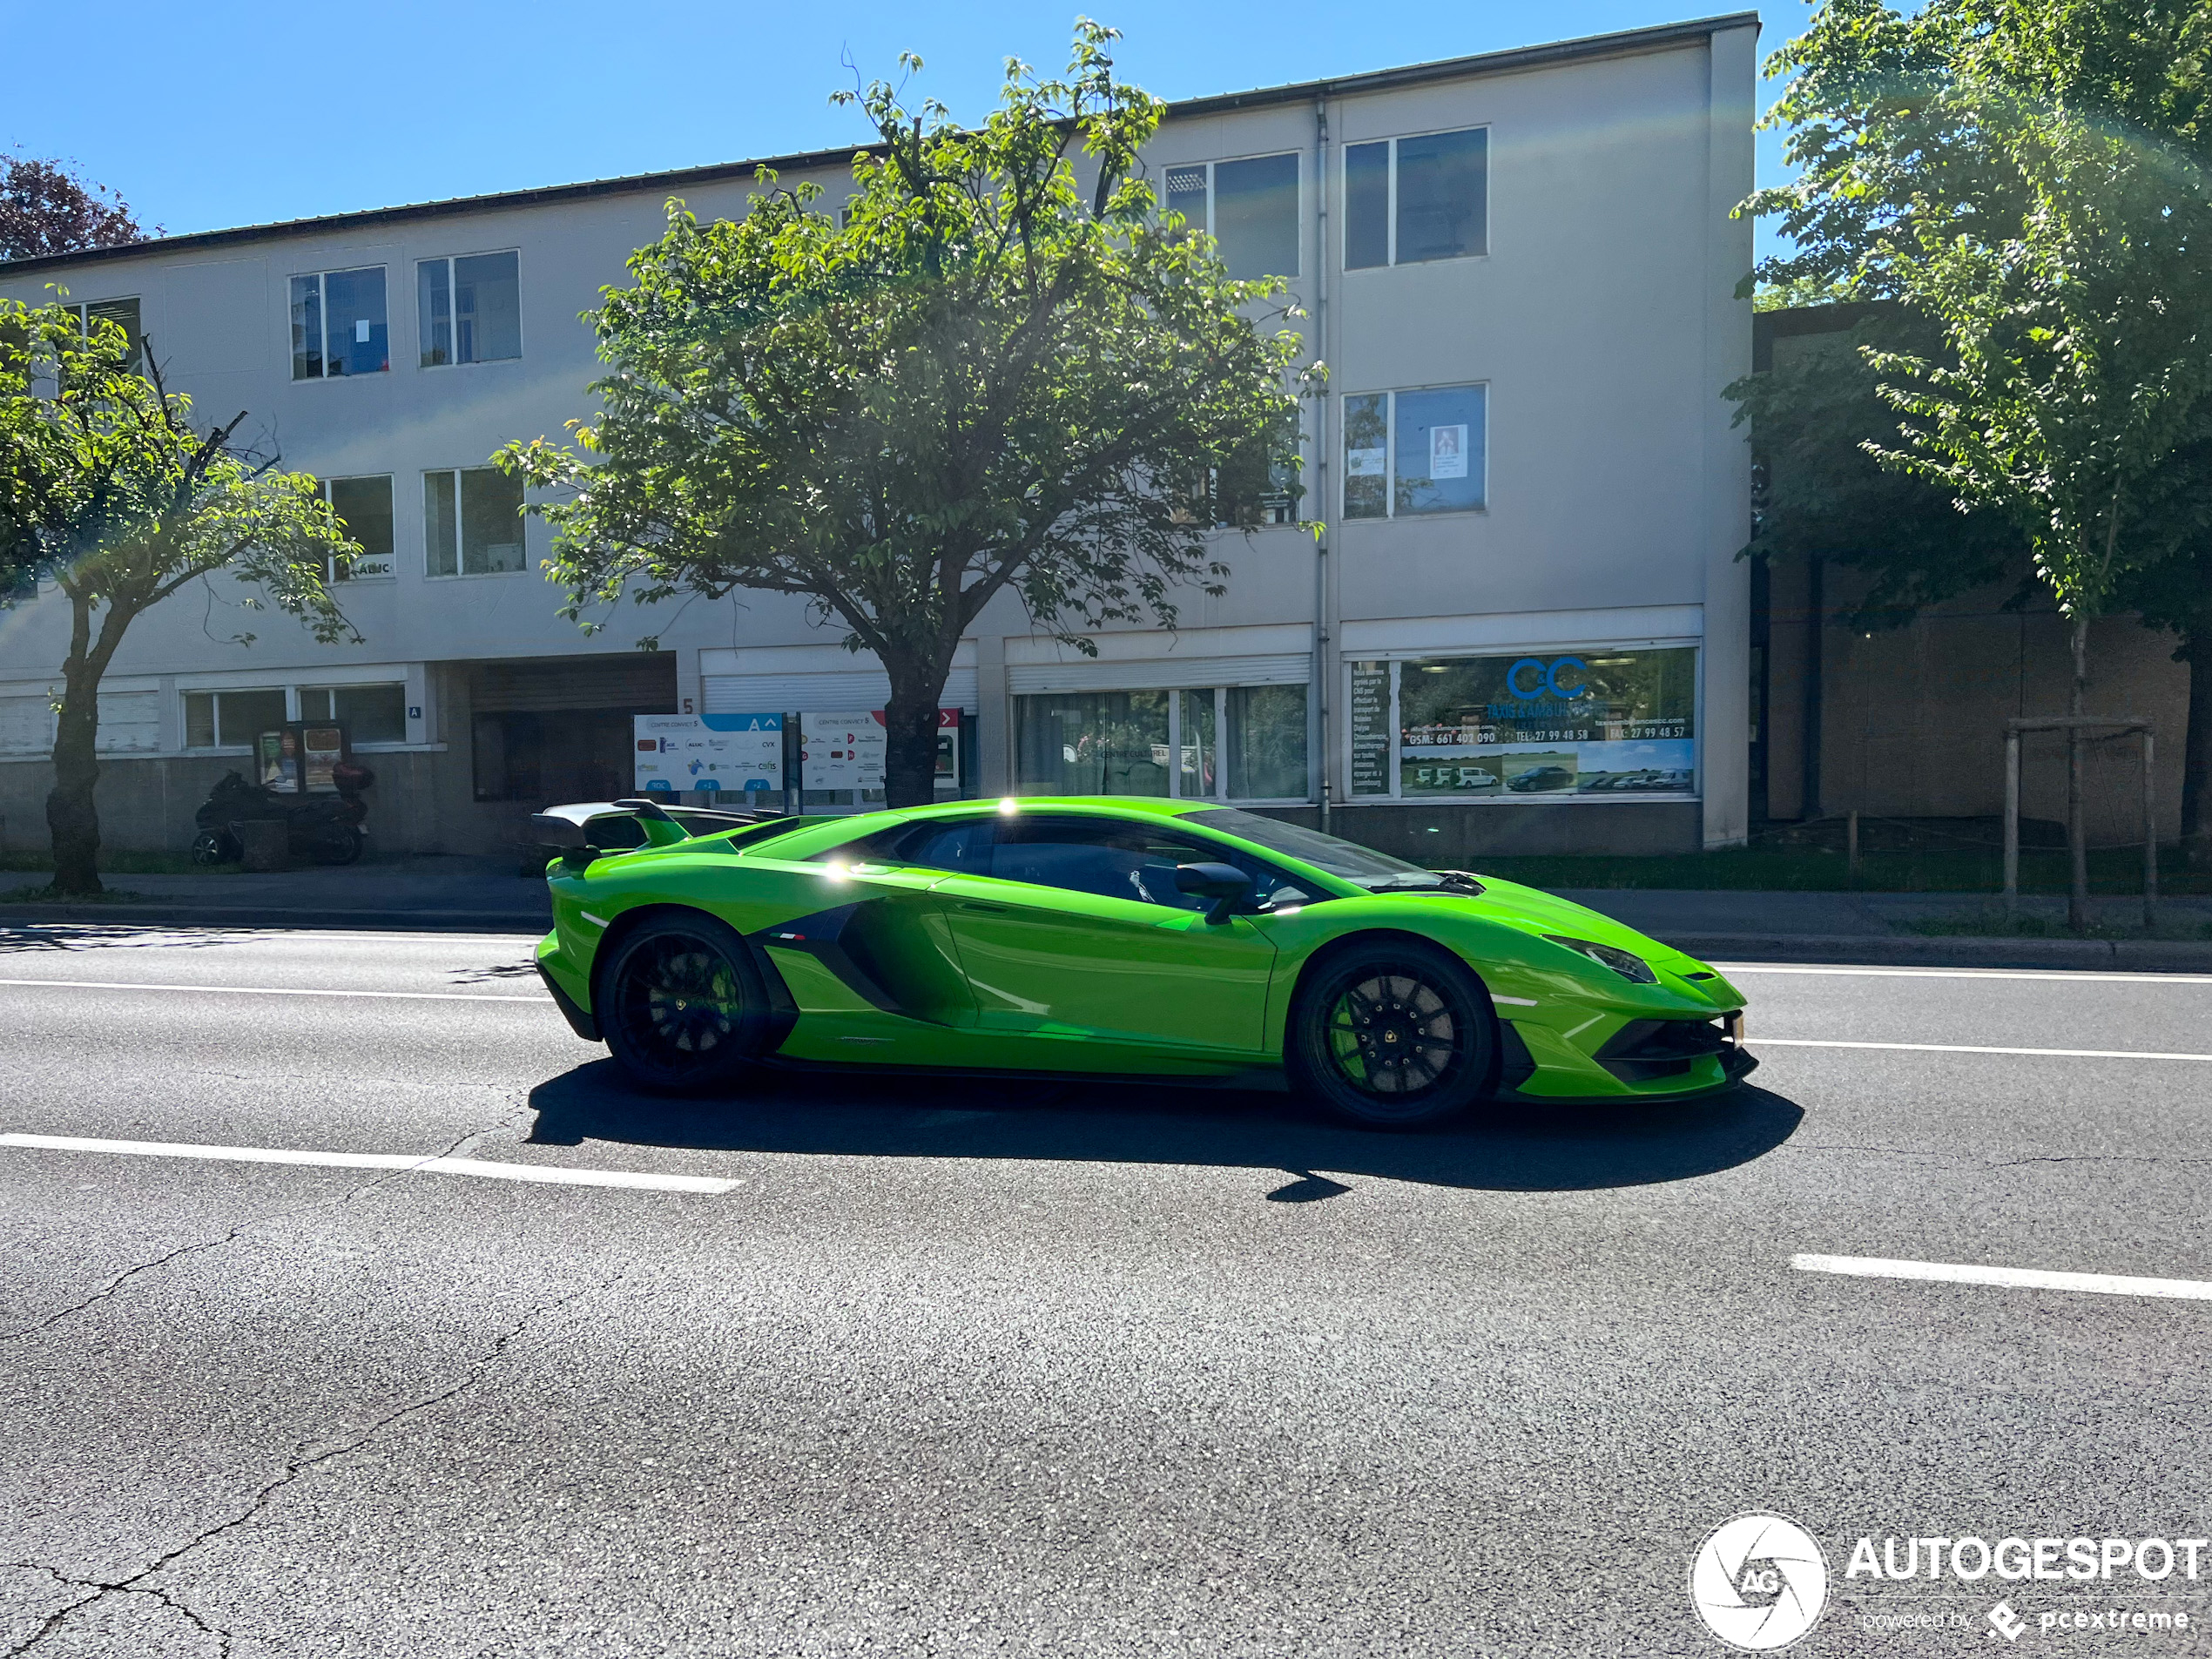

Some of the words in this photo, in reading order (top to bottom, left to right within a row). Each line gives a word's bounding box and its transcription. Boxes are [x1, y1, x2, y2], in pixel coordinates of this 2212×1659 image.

[684, 698, 693, 714] 5
[748, 718, 760, 732] A
[1436, 734, 1452, 744] 661
[1456, 733, 1474, 743] 402
[1477, 732, 1495, 743] 090
[1535, 731, 1545, 740] 27
[1549, 731, 1560, 740] 99
[1563, 730, 1574, 739] 48
[1577, 730, 1588, 739] 58
[1631, 728, 1642, 738] 27
[1645, 727, 1656, 738] 99
[1659, 727, 1670, 737] 48
[1674, 726, 1684, 737] 57
